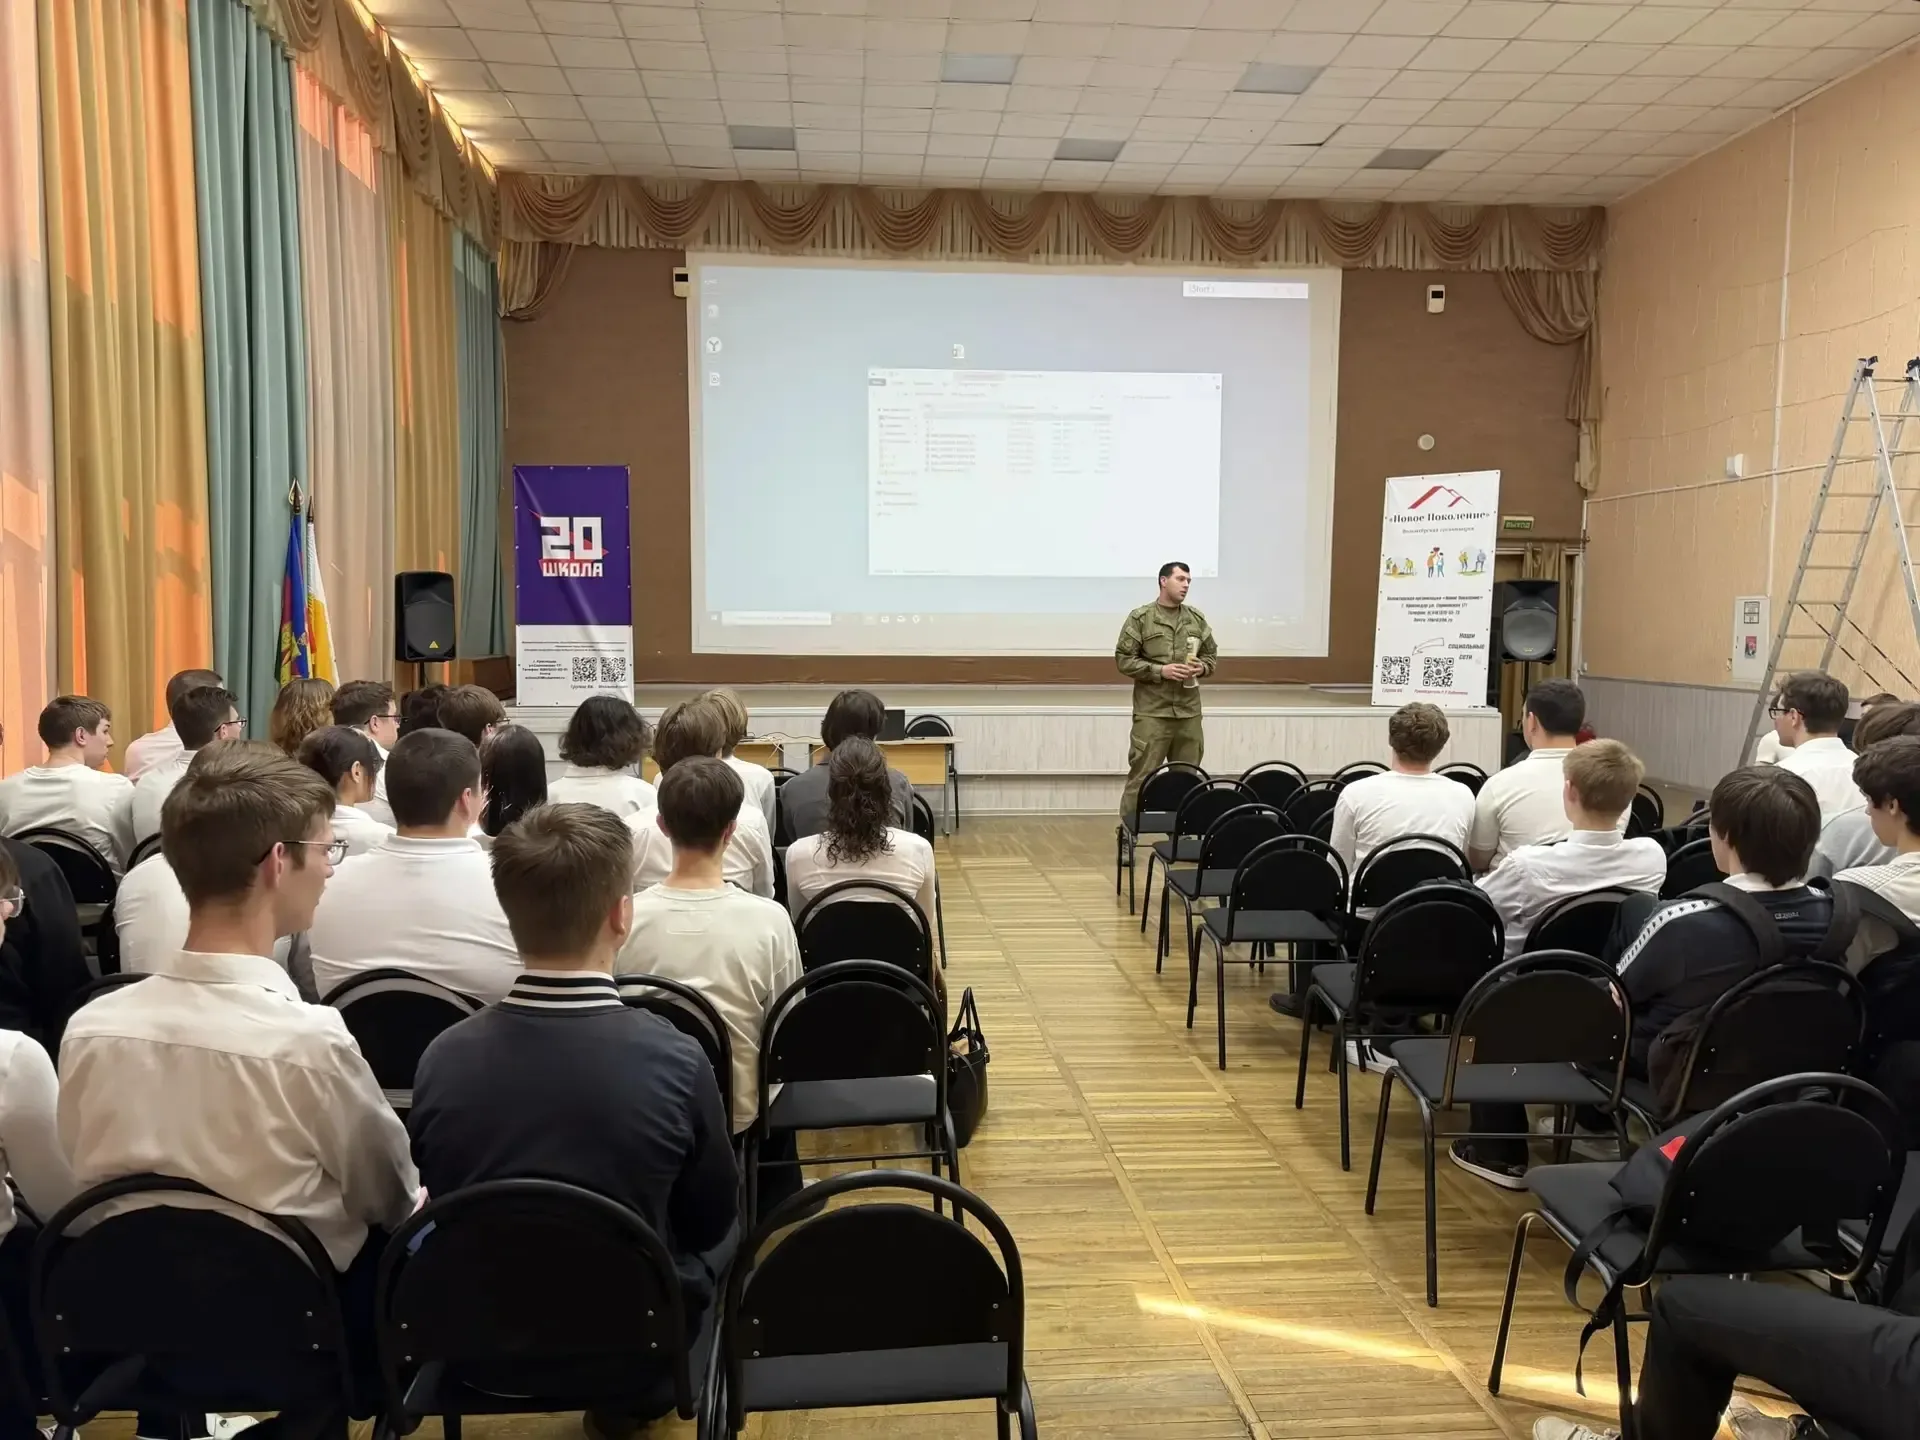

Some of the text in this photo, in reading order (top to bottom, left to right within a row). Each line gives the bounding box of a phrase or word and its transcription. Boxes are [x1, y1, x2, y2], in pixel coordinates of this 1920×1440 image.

[1389, 511, 1490, 524] «Новое Поколение»
[541, 517, 603, 560] 20
[542, 562, 604, 577] ШКОЛА
